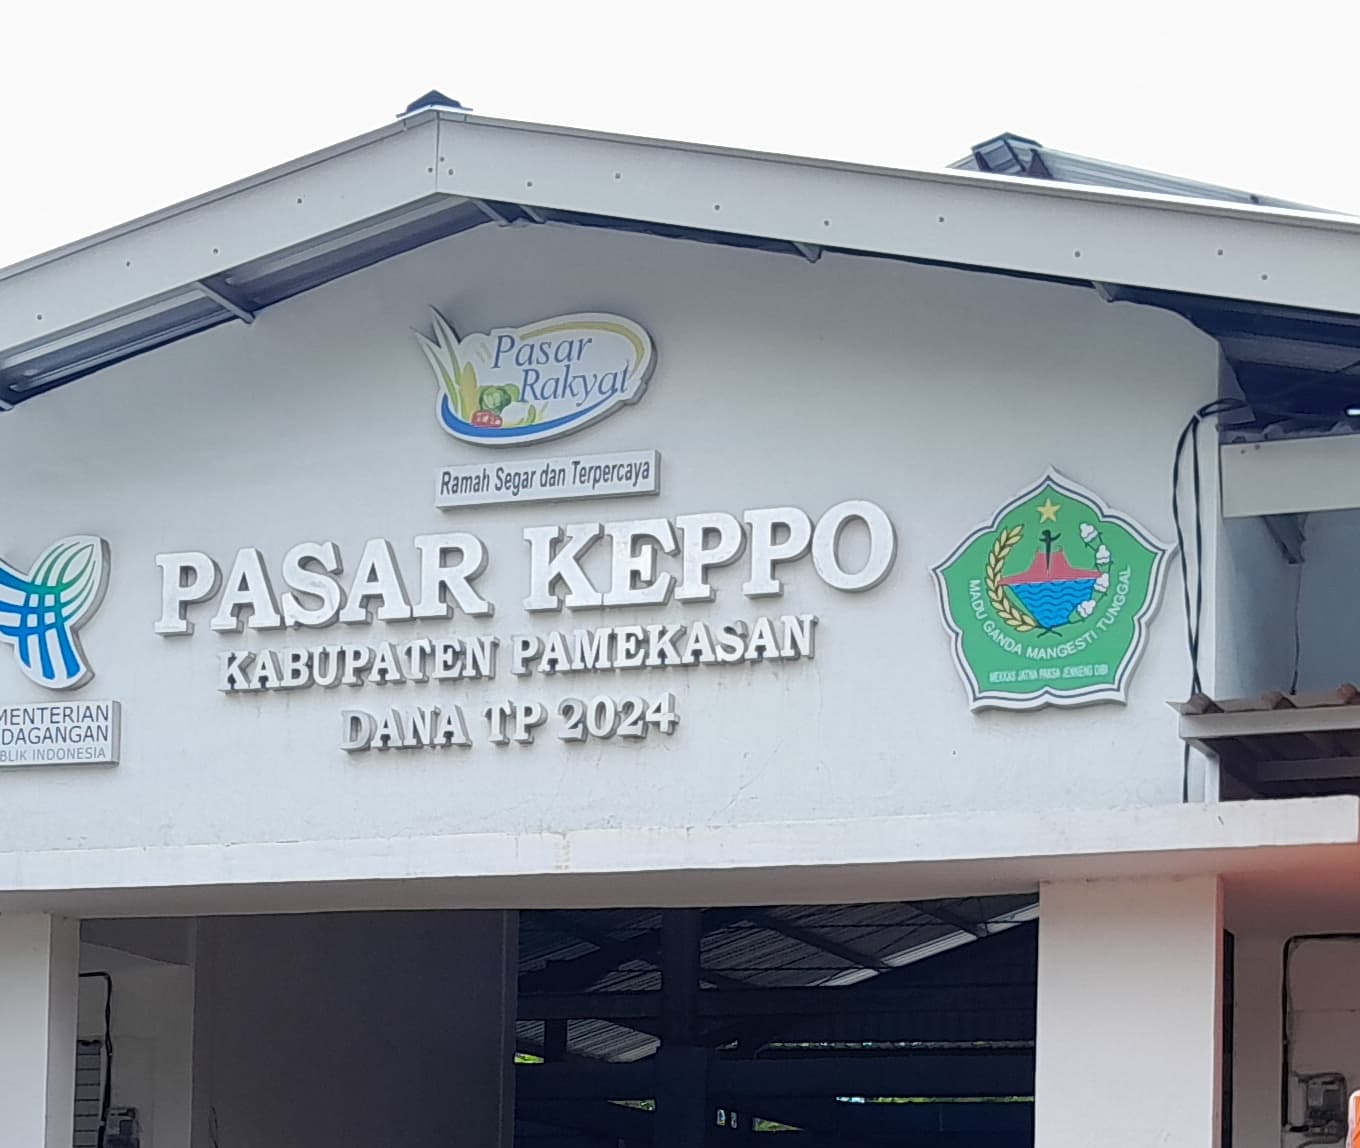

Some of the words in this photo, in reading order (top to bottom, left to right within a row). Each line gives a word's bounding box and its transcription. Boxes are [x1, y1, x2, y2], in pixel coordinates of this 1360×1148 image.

[491, 334, 593, 369] Pasar
[520, 360, 630, 407] Rakyat
[440, 467, 490, 496] Ramah
[494, 466, 537, 496] Segar
[540, 463, 566, 488] dan
[571, 459, 651, 488] Terpercaya
[154, 532, 494, 636] PASAR
[523, 500, 898, 613] KEPPO
[968, 578, 988, 621] MADU
[983, 619, 1023, 657] GANDA
[1025, 629, 1099, 660] MANGESTI
[1095, 564, 1132, 633] TUNGGAL
[218, 636, 500, 694] KABUPATEN
[511, 614, 819, 675] PAMEKASAN
[340, 704, 473, 753] DANA
[483, 699, 548, 744] TP
[557, 692, 680, 743] 2024
[32, 746, 107, 762] INDONESIA
